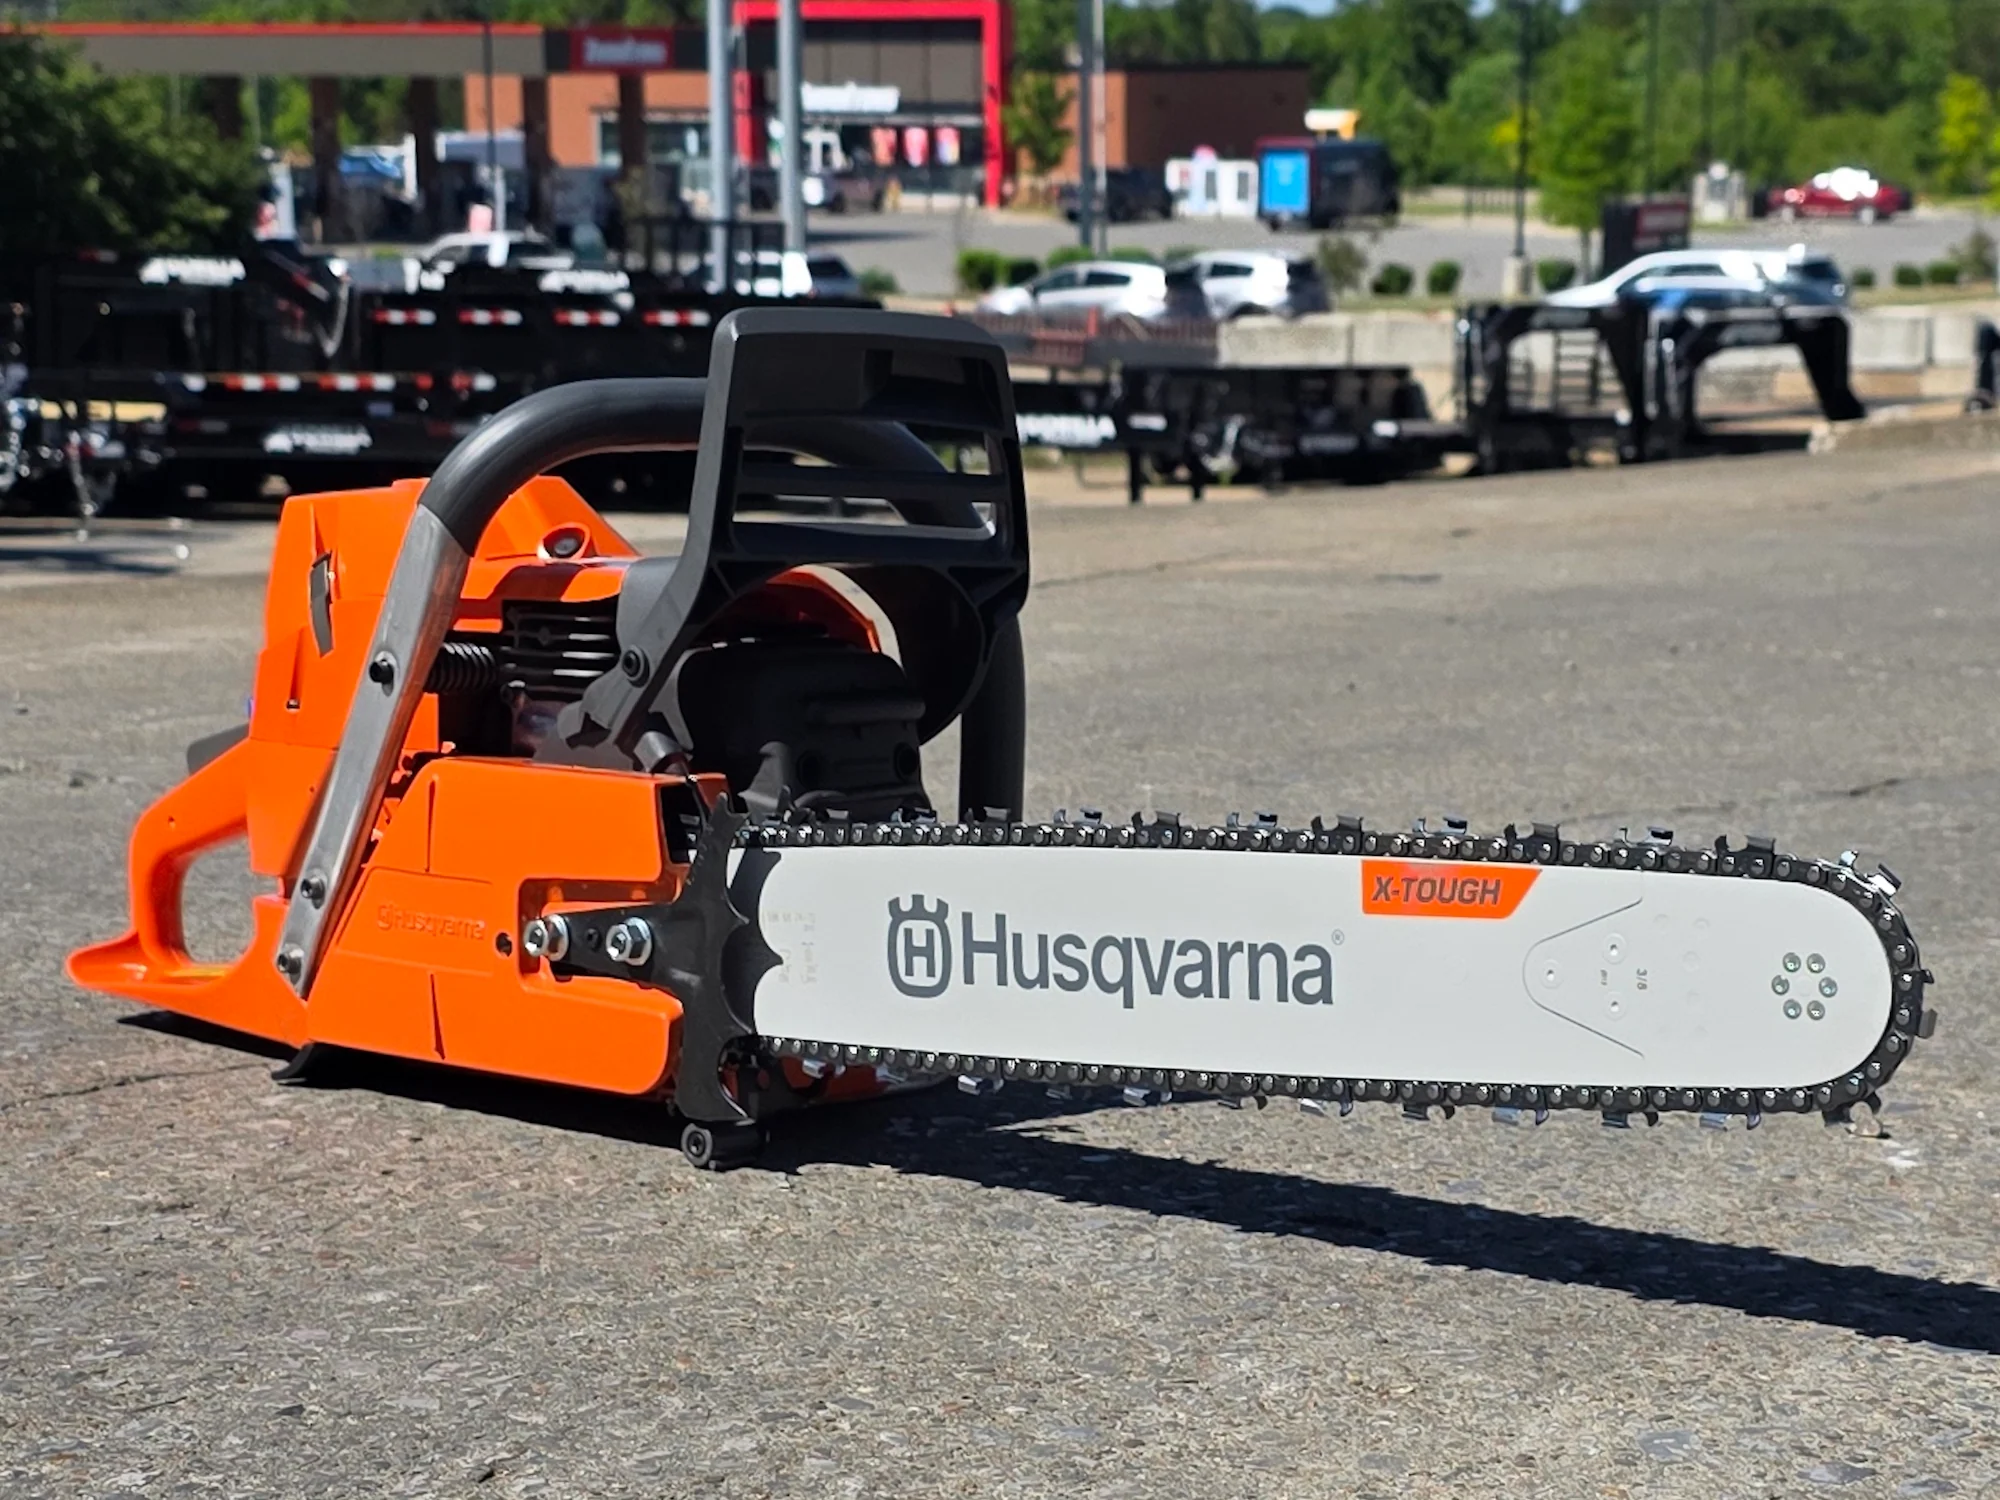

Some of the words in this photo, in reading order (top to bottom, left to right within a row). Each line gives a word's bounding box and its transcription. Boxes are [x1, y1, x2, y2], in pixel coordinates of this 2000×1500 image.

[1372, 876, 1500, 905] X-TOUGH
[962, 911, 1334, 1009] Husqvarna
[1636, 968, 1648, 990] 3/8
